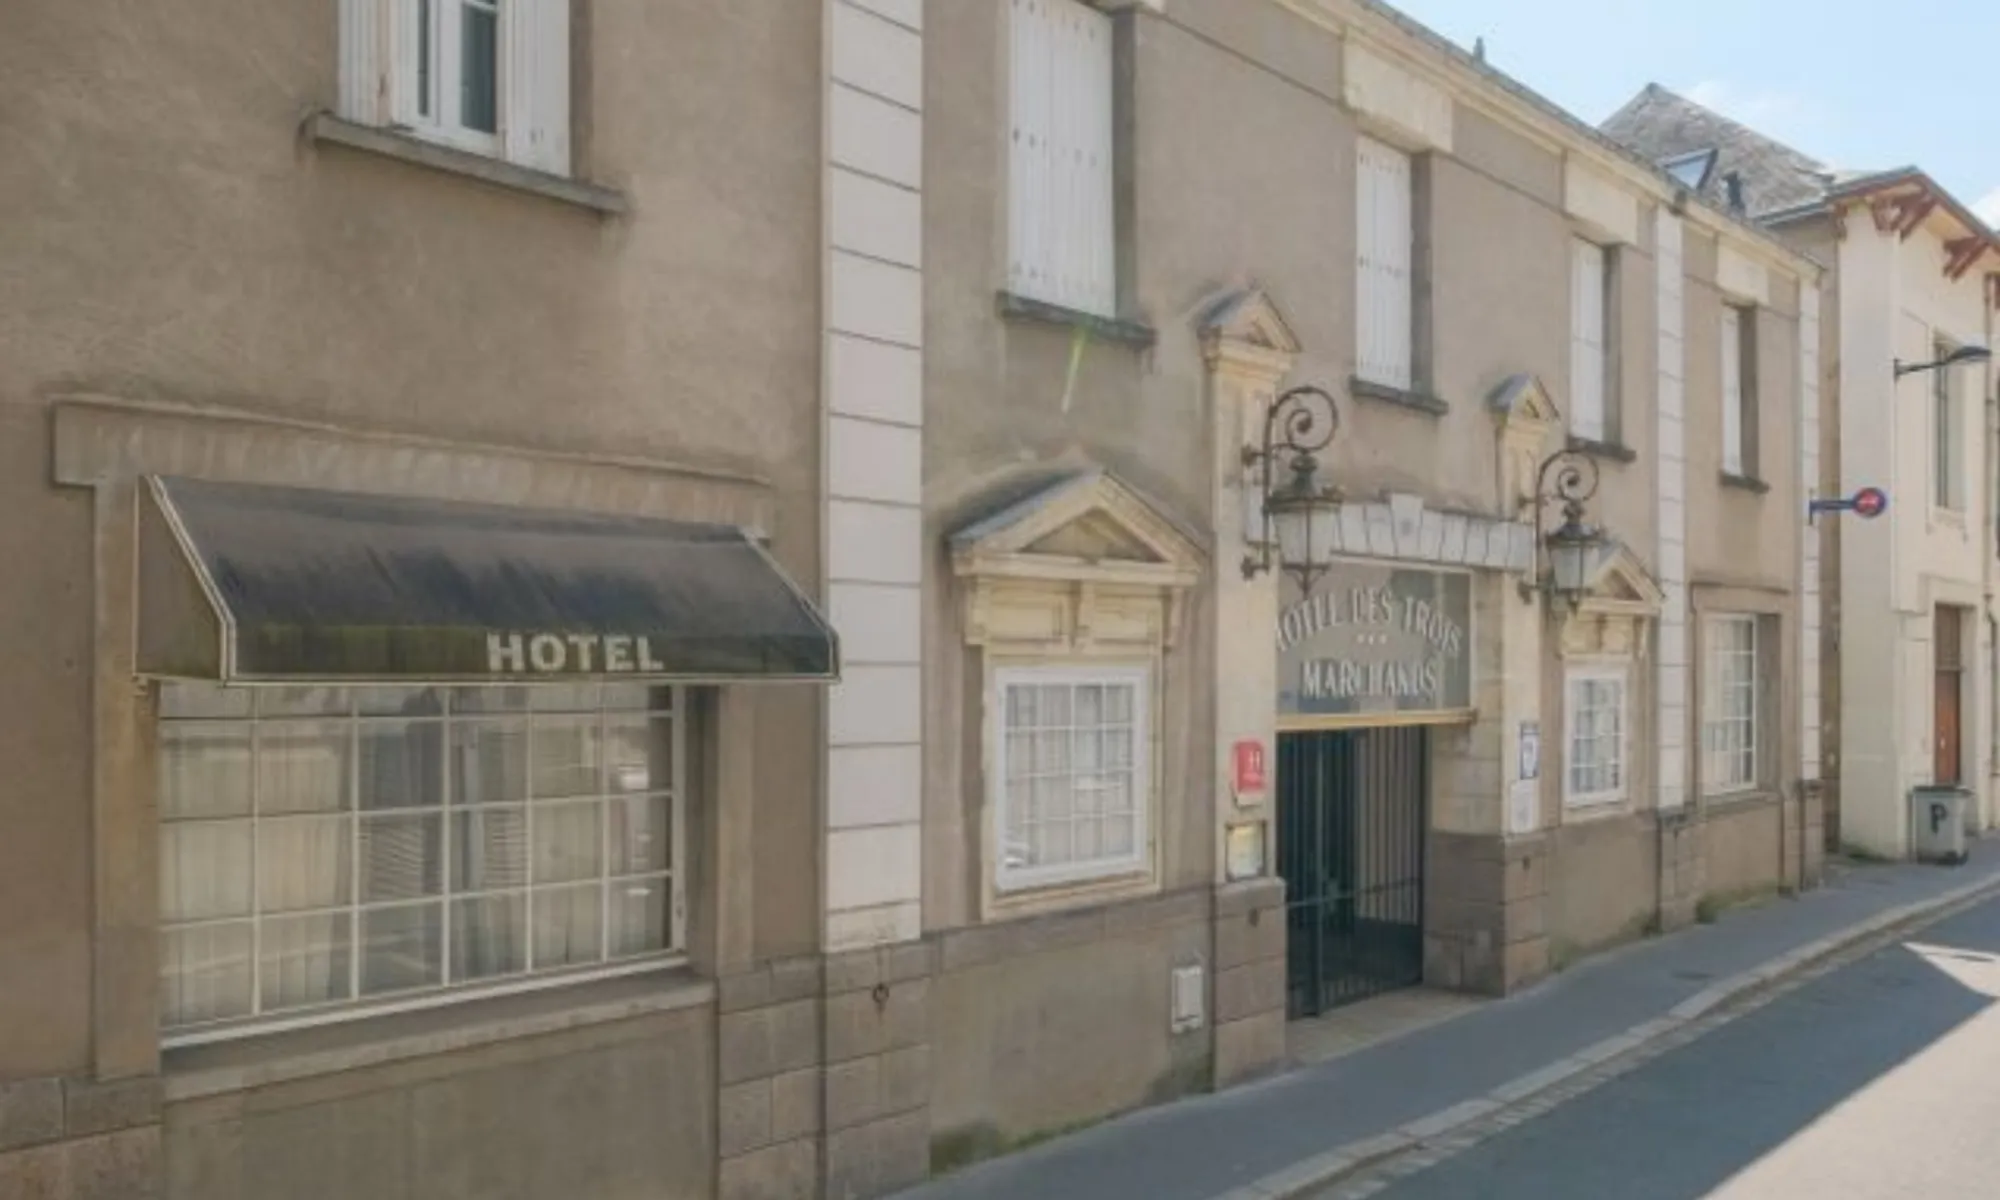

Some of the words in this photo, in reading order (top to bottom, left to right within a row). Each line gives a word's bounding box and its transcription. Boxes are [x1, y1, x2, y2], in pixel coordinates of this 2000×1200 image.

[1352, 585, 1392, 626] DES
[1402, 595, 1463, 656] TROIS
[486, 632, 664, 672] HOTEL
[1302, 657, 1437, 700] MARCHANDS
[1930, 803, 1948, 834] P
